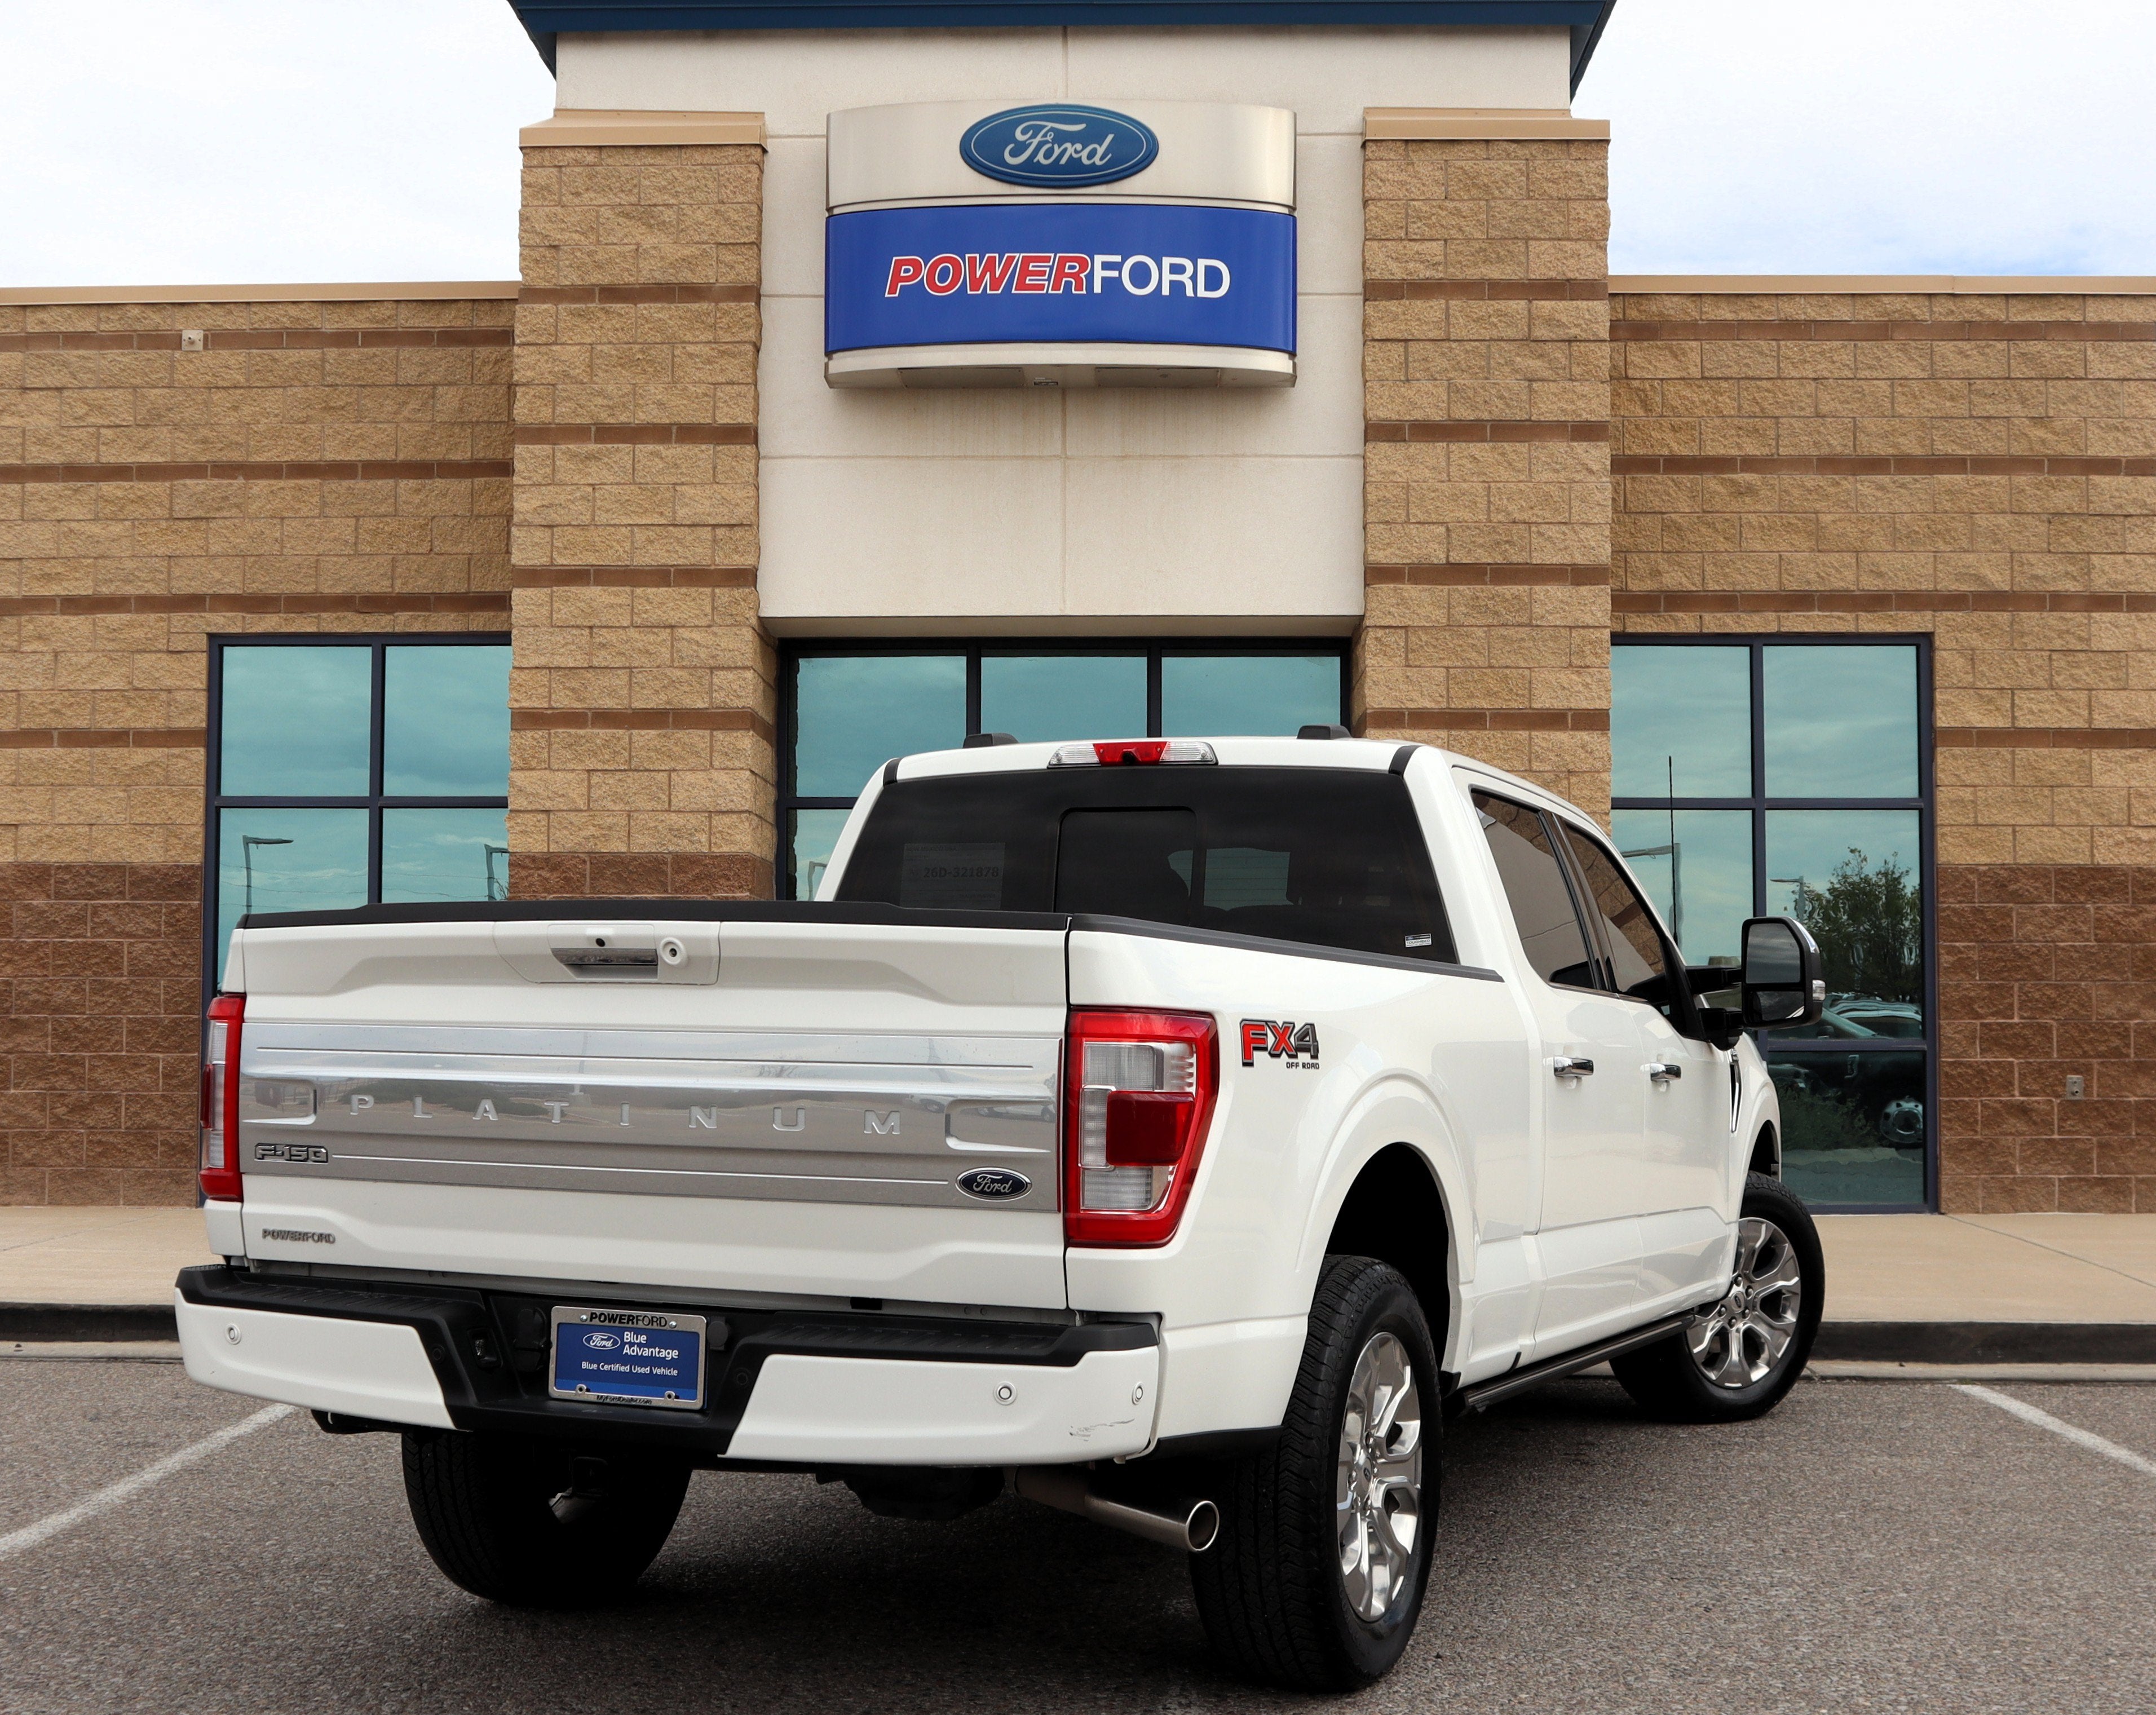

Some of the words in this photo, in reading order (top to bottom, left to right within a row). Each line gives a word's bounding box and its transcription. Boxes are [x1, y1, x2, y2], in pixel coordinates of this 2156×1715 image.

[1004, 121, 1114, 166] Ford
[885, 253, 1231, 298] POWERFORD
[924, 867, 999, 878] 26D-321878
[1239, 1018, 1319, 1067] FX4
[350, 1094, 901, 1134] PLATINUM
[255, 1143, 328, 1164] F-150
[973, 1174, 1013, 1193] Ford
[262, 1228, 335, 1244] POWERFORD
[589, 1312, 667, 1327] POWERFORD
[590, 1334, 613, 1347] Ford
[624, 1332, 647, 1343] Blue
[622, 1344, 678, 1360] Advantage
[581, 1362, 598, 1370] Blue
[599, 1363, 630, 1373] Certified
[632, 1364, 650, 1374] Used
[652, 1366, 678, 1376] Vehicle
